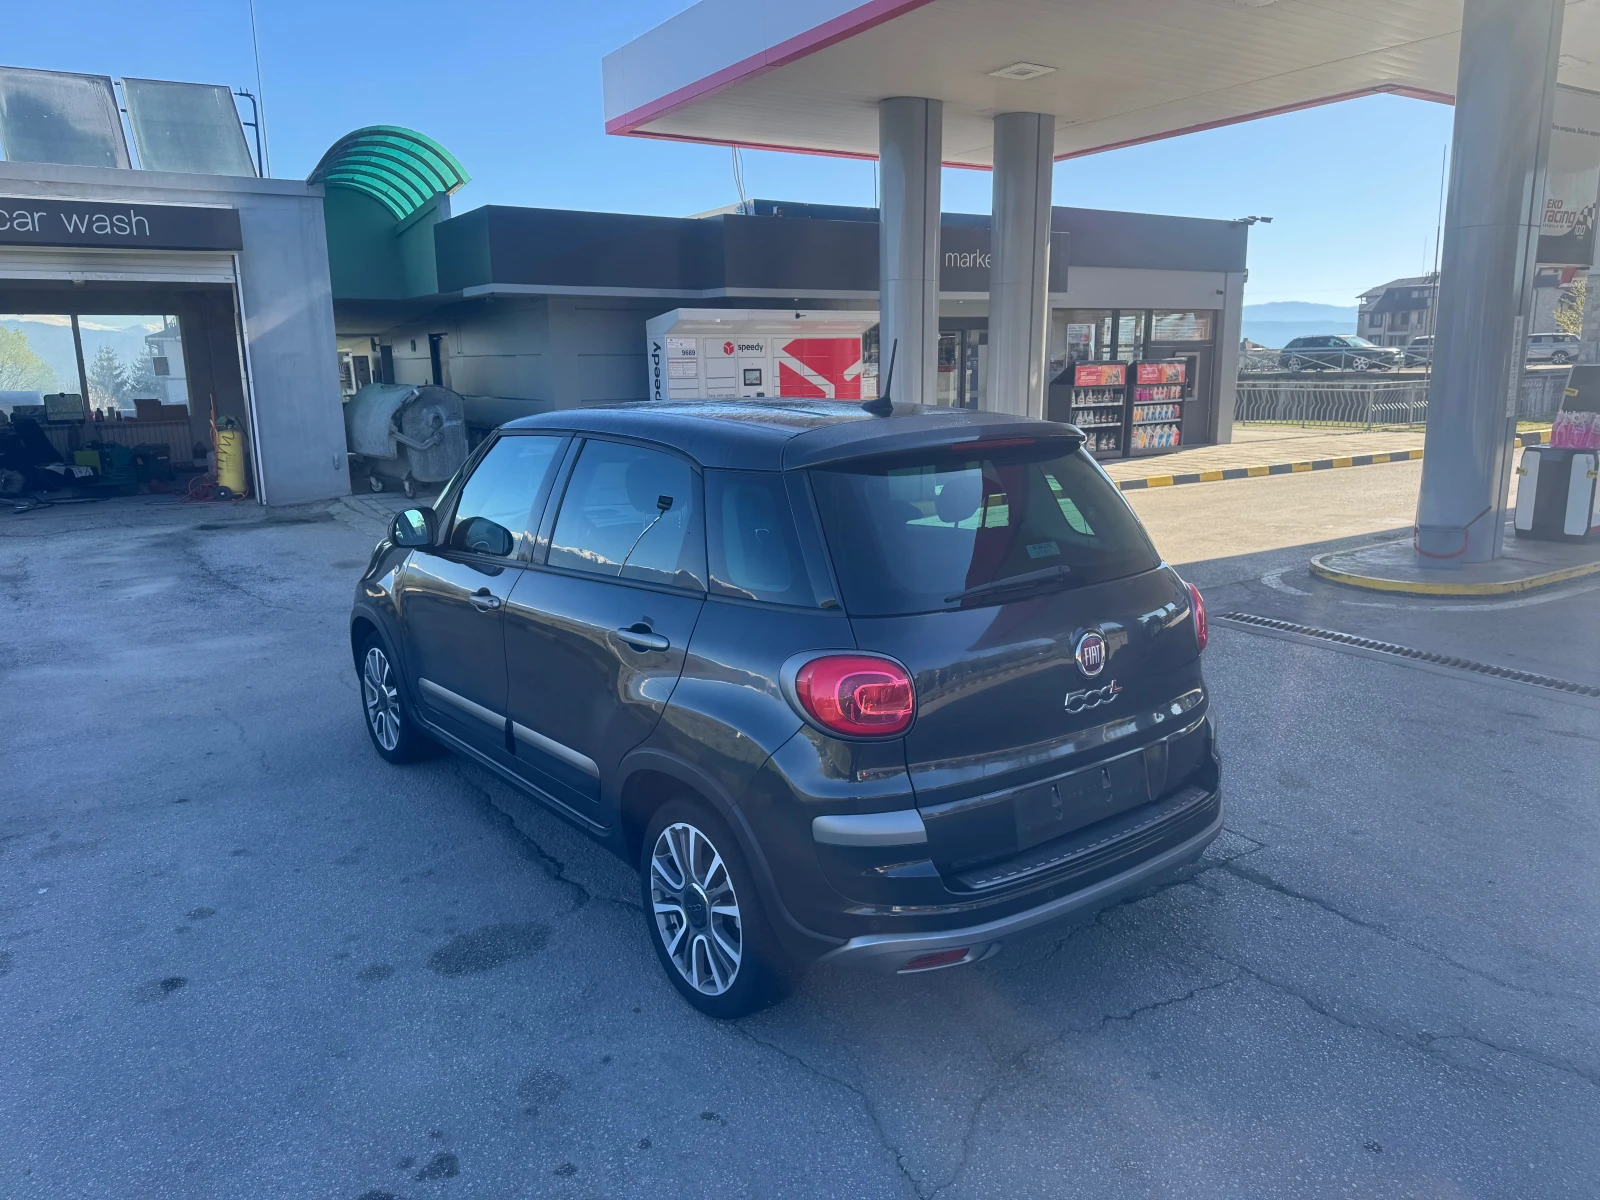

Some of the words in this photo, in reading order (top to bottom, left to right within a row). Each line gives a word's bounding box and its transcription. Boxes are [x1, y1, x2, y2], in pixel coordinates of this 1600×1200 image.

[1547, 199, 1563, 209] EKO
[60, 209, 150, 236] wash
[1543, 210, 1577, 229] racing
[945, 248, 991, 268] marke
[737, 342, 764, 353] speedy
[651, 341, 663, 400] peedy
[1084, 644, 1100, 666] FIAT
